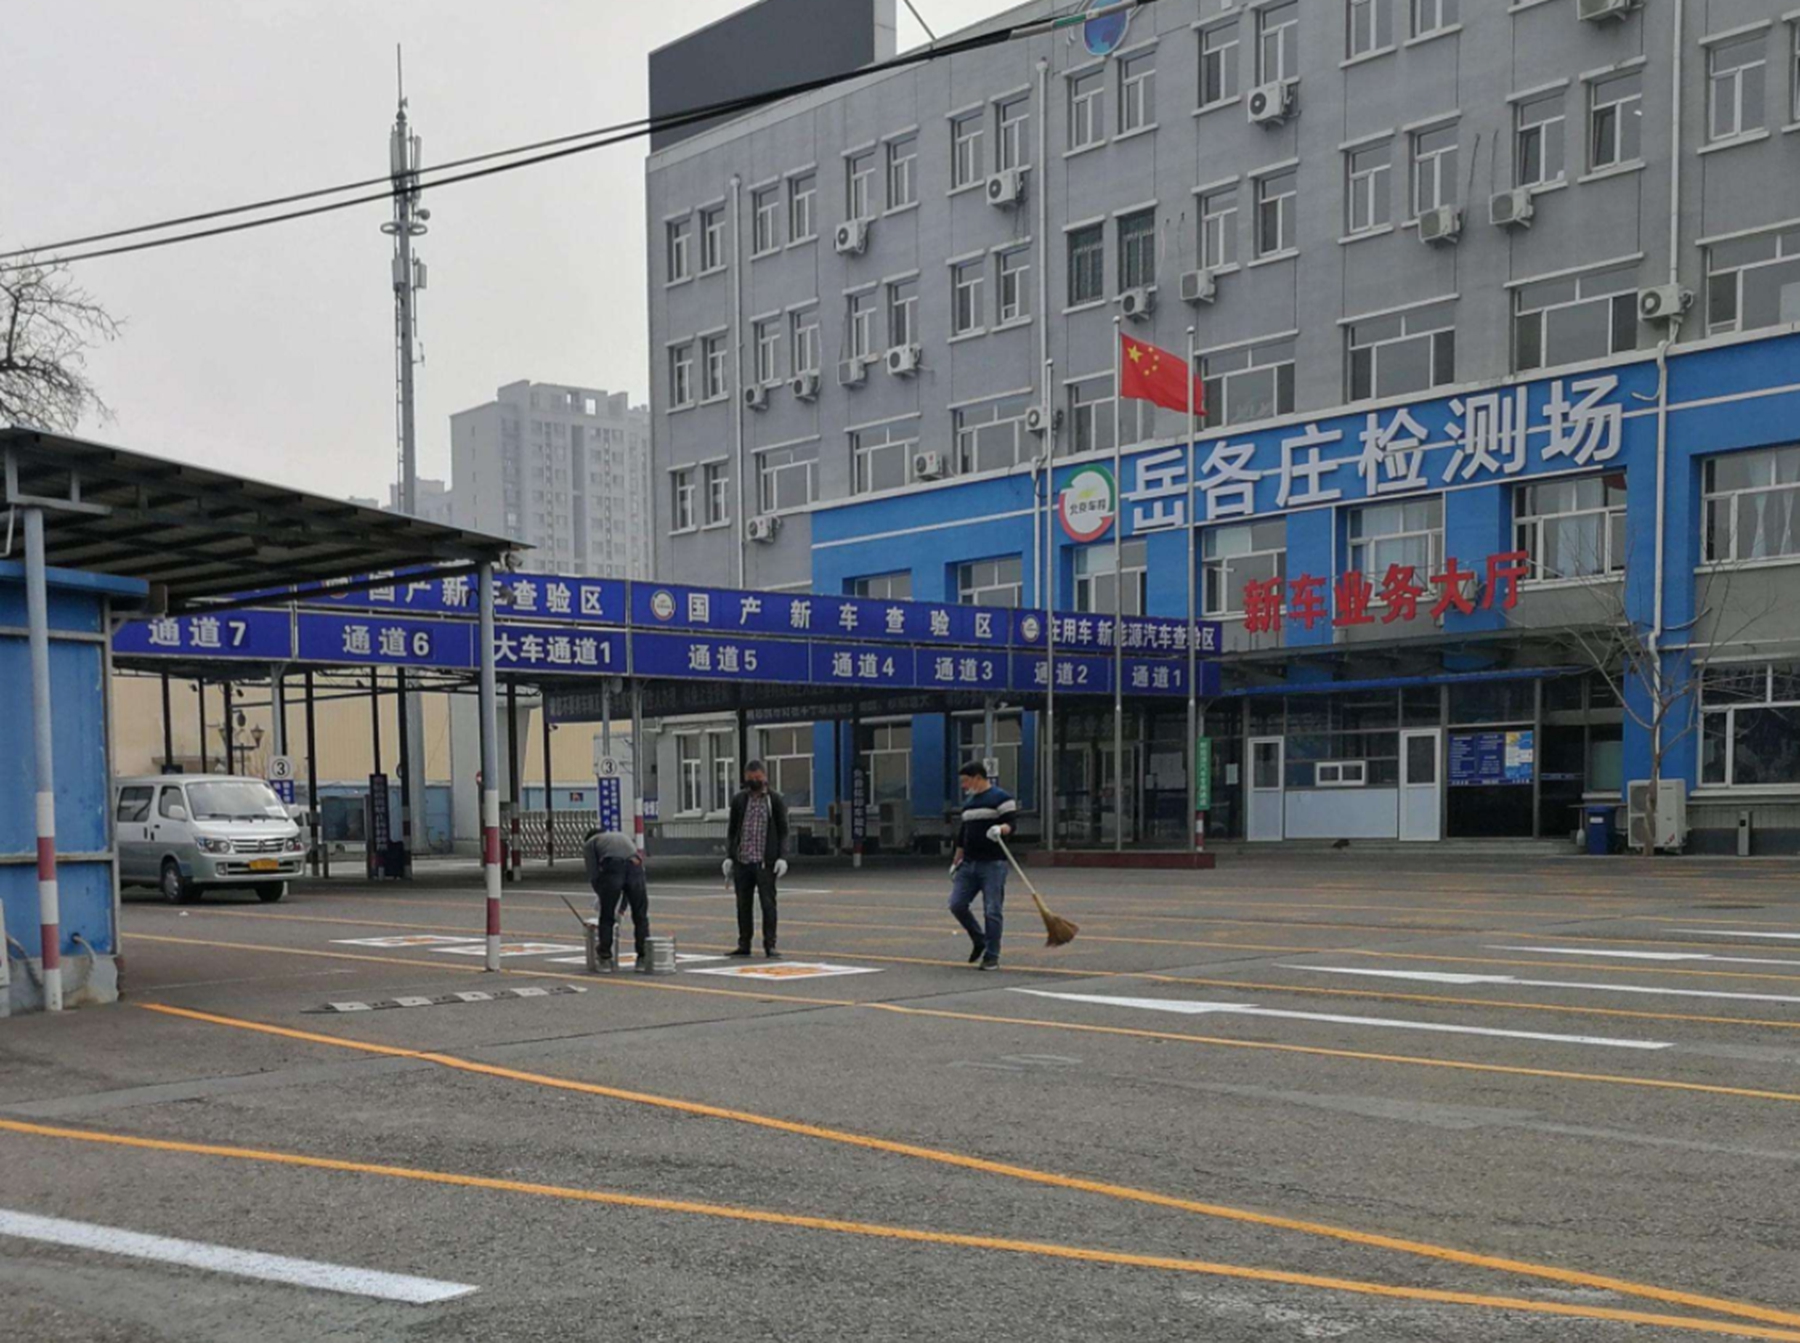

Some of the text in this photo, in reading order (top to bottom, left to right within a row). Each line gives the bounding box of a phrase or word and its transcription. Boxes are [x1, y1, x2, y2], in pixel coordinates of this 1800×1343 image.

[1131, 375, 1623, 533] 岳各庄检测场
[1243, 550, 1528, 633] 新车业务大厅
[687, 593, 992, 638] 国产新车查验区
[148, 618, 247, 648] 通道7
[342, 624, 430, 657] 通道6
[494, 633, 611, 665] 大车通道1
[688, 643, 758, 672] 通道5
[831, 652, 895, 678] 通道4
[934, 656, 993, 682] 通道3
[1034, 661, 1088, 684] 通道2
[1132, 665, 1182, 688] 通道1
